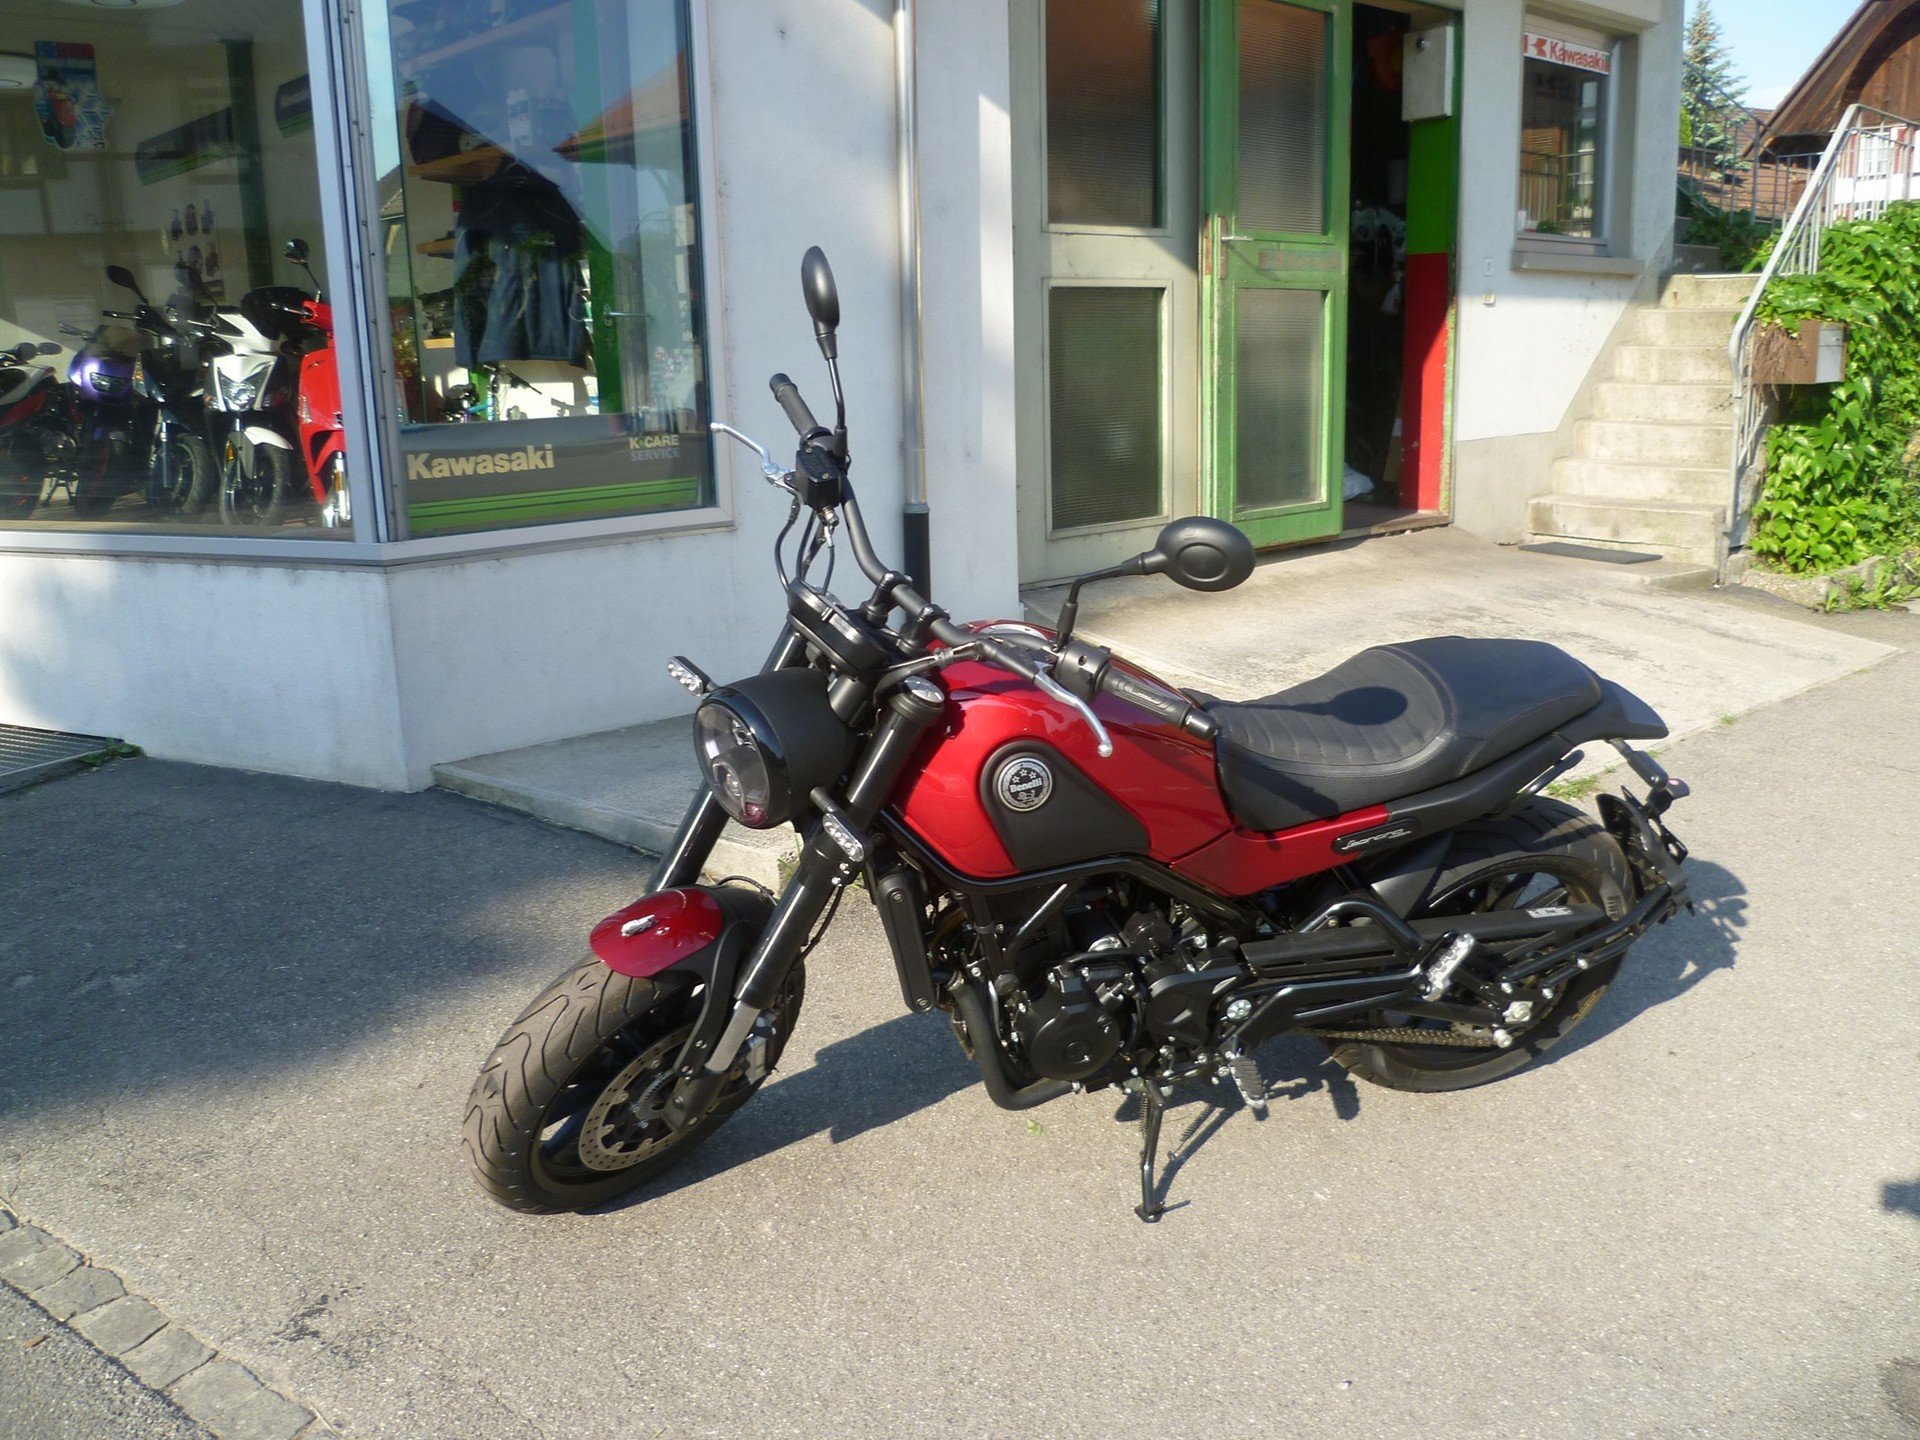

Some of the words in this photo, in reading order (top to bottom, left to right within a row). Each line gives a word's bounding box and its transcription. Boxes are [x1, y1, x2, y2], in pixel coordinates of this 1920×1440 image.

[1550, 41, 1605, 69] Kawasaki
[407, 444, 555, 480] Kawasaki
[630, 448, 680, 462] SERVICE
[1009, 777, 1043, 793] Benelli
